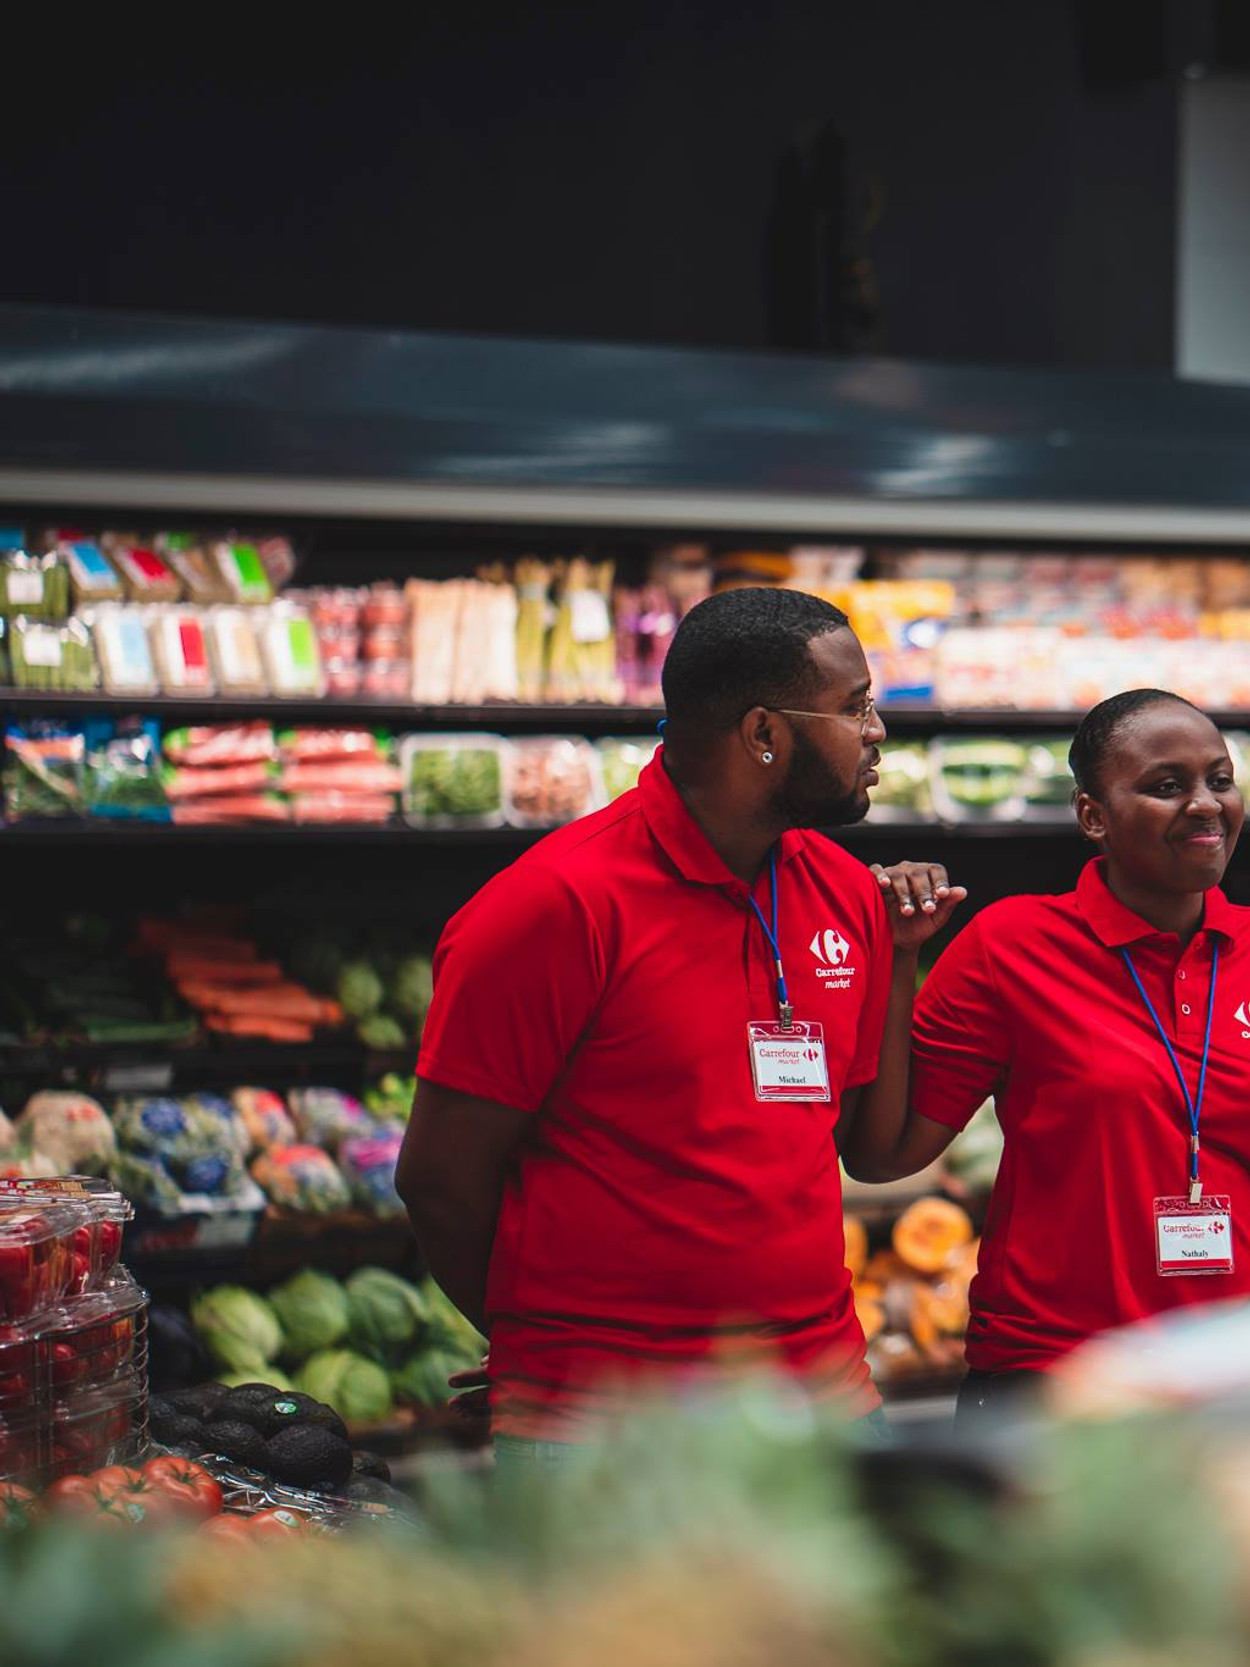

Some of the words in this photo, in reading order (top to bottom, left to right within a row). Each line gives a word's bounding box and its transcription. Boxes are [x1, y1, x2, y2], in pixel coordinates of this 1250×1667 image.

[815, 966, 855, 978] Carrefour
[760, 1048, 800, 1058] Carrefour
[778, 1075, 806, 1084] Michael
[1181, 1249, 1209, 1259] Nathaly
